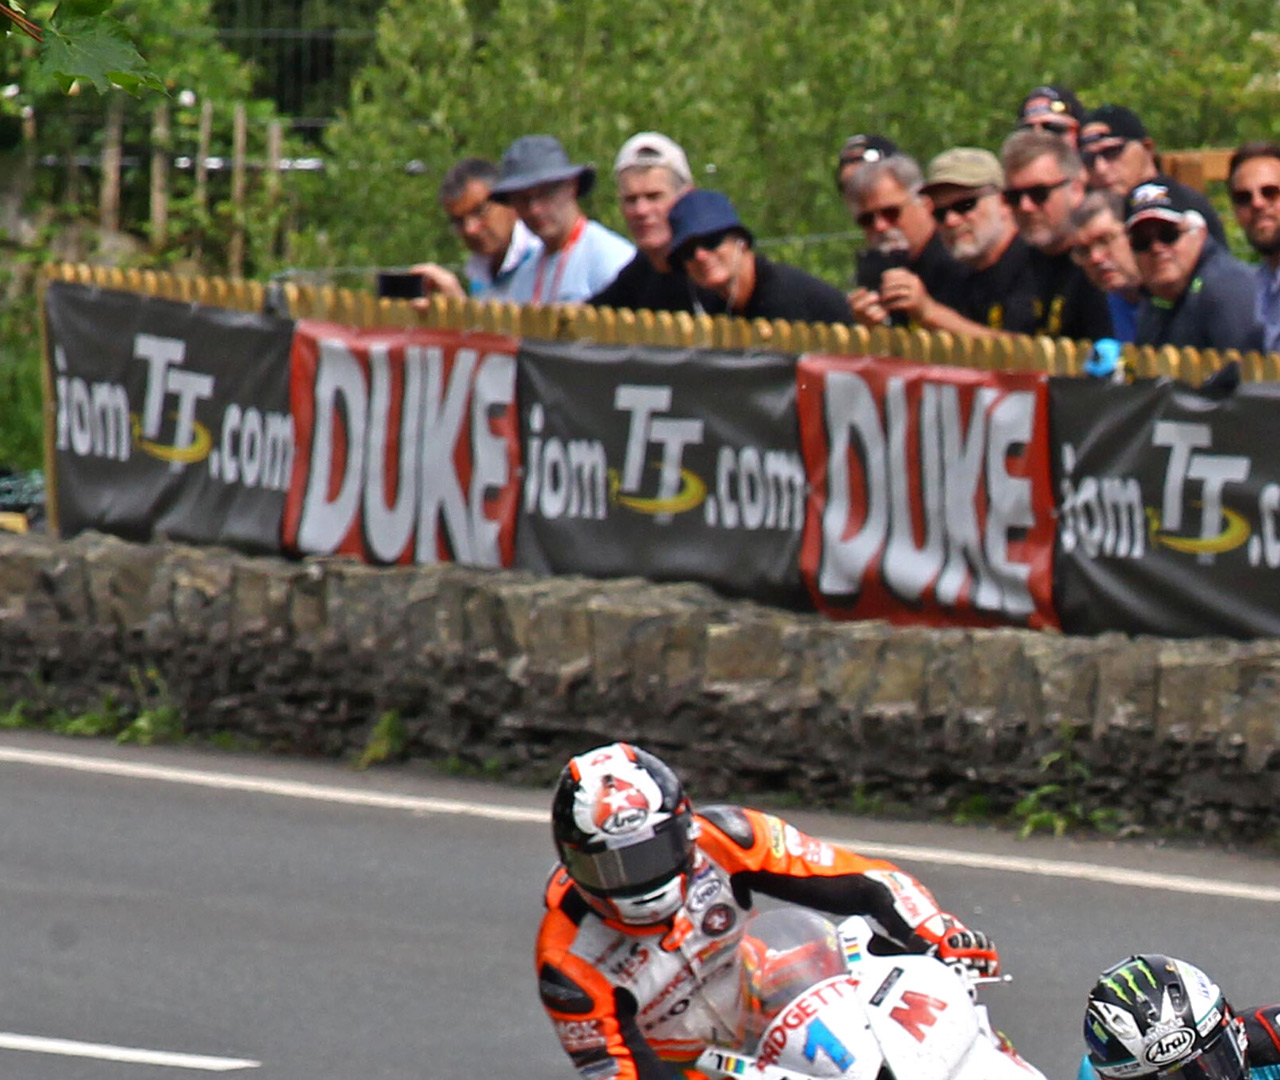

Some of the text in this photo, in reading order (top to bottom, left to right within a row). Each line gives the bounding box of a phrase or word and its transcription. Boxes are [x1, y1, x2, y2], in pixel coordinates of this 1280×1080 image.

[300, 338, 517, 567] DUKE
[524, 384, 804, 530] iomTT.com
[819, 371, 1036, 616] DUKE
[803, 1016, 855, 1073] 1
[1149, 1032, 1193, 1061] Arai
